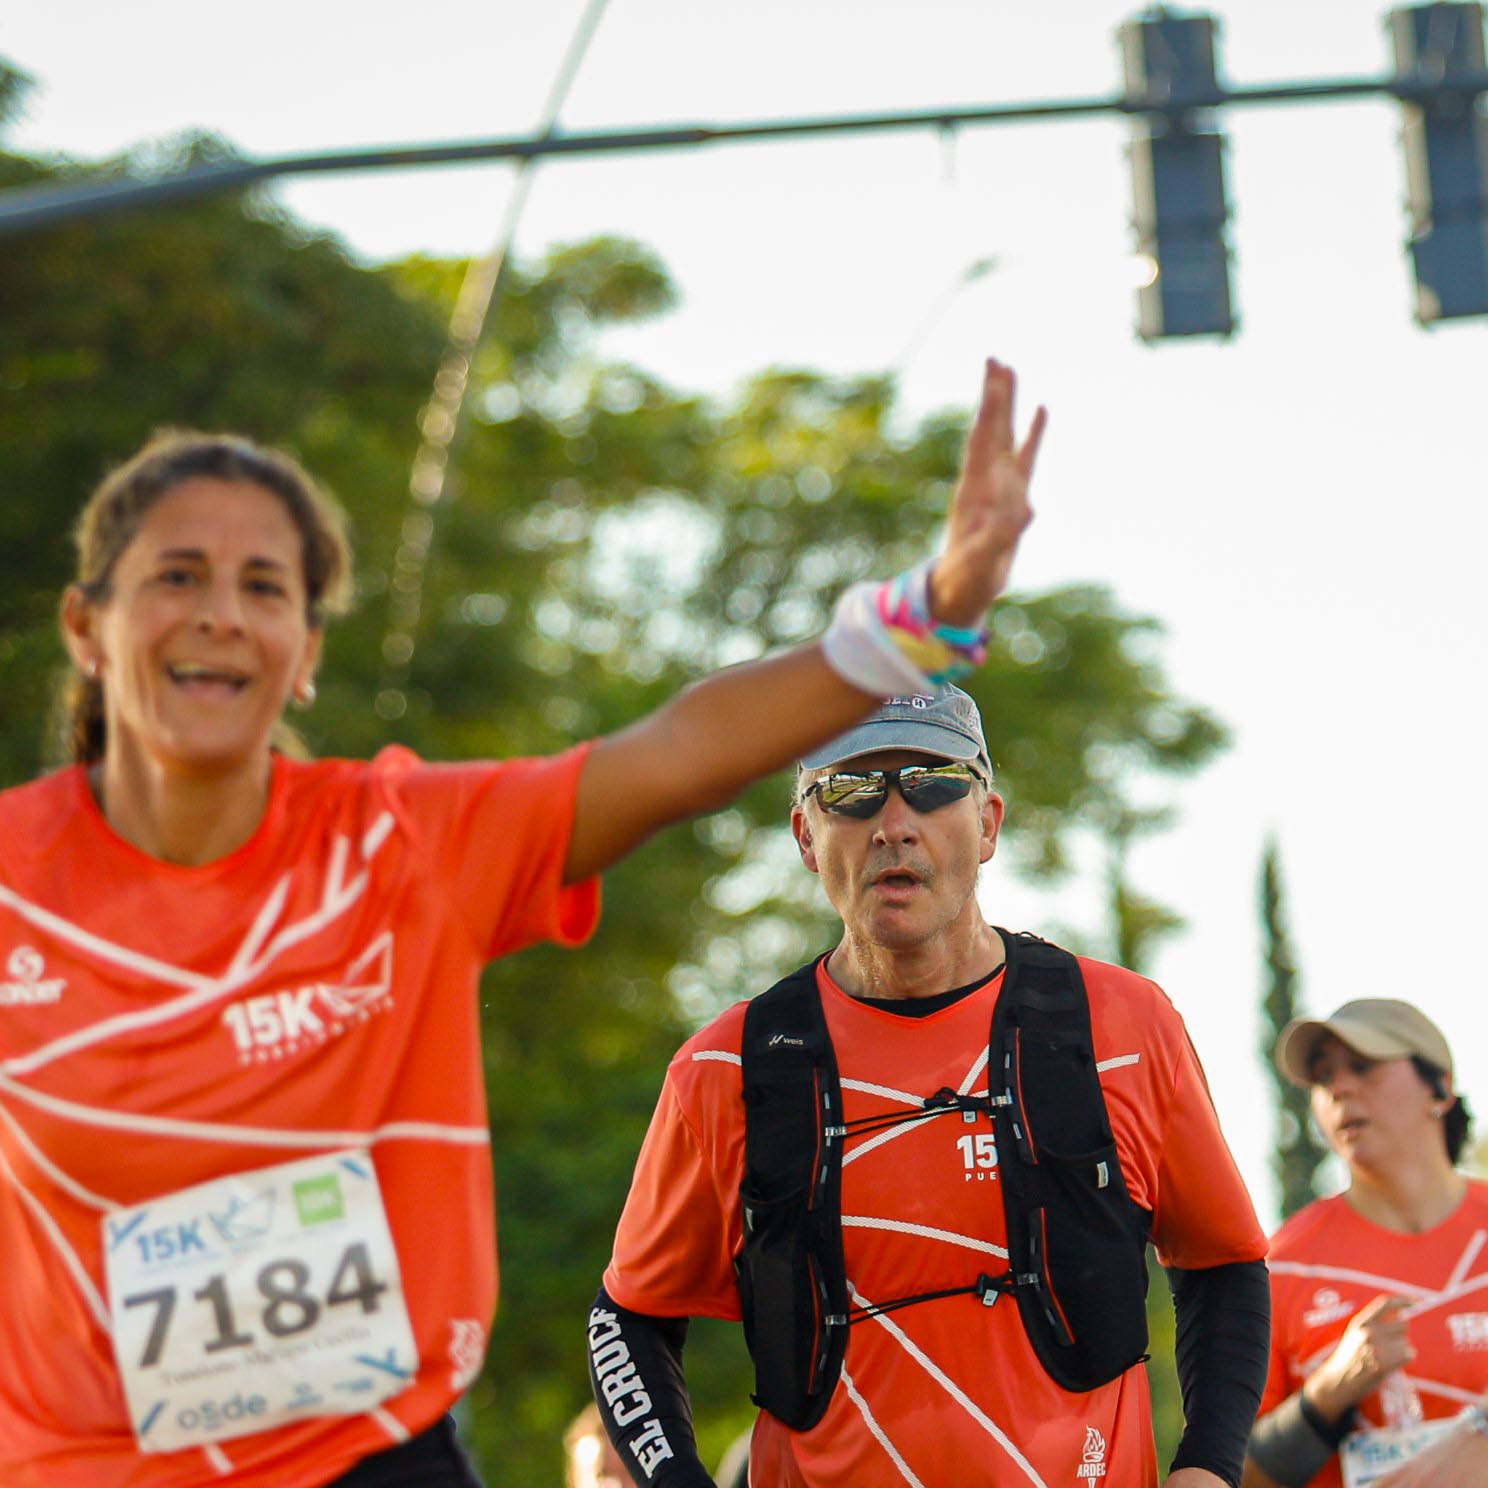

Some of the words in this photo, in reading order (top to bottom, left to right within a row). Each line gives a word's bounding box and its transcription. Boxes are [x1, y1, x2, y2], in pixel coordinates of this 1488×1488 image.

[222, 985, 324, 1049] 15K
[956, 1135, 999, 1168] 15
[136, 1218, 206, 1263] 15K
[123, 1240, 388, 1369] 7184
[177, 1392, 267, 1430] osde
[629, 1418, 675, 1479] EL
